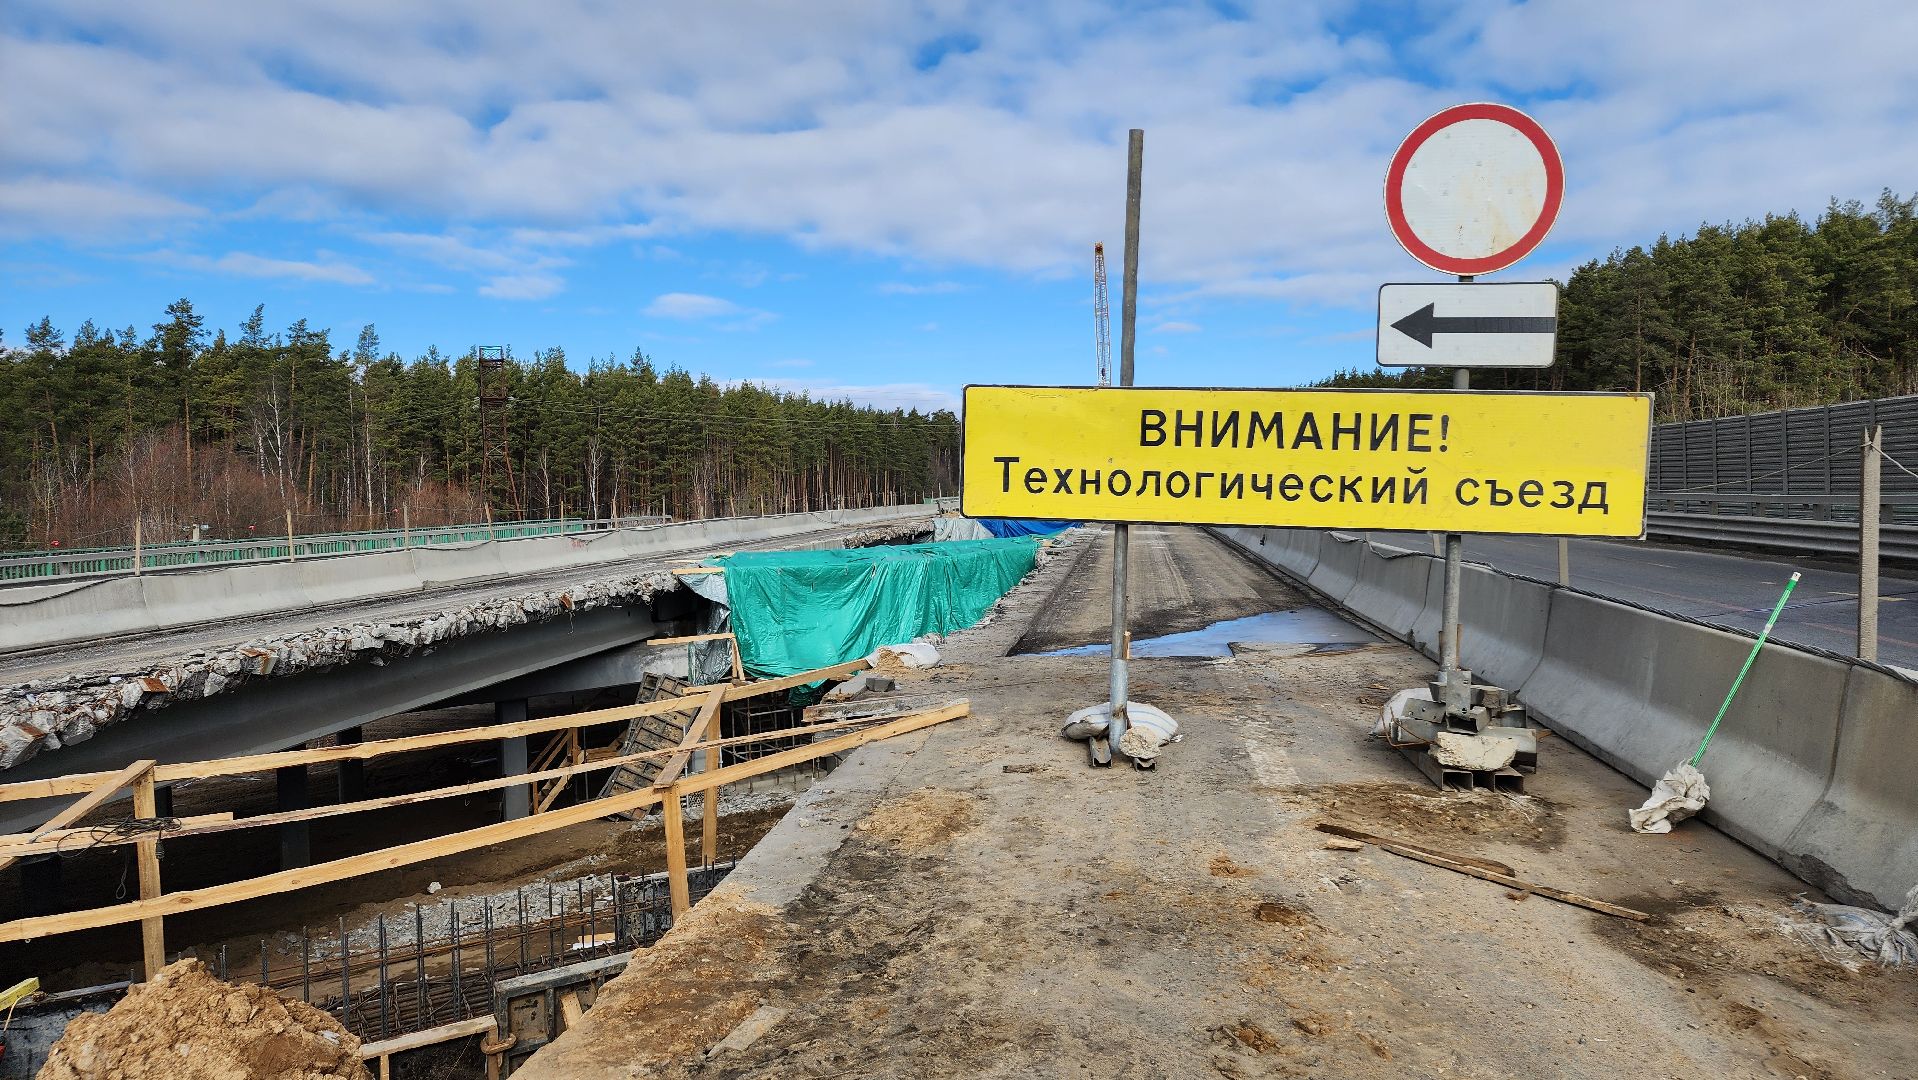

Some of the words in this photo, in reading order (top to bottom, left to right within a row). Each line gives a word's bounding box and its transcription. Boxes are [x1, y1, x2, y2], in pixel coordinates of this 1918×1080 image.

[1140, 409, 1450, 453] ВНИМАНИЕ!
[993, 456, 1428, 505] Технологический
[1455, 477, 1609, 515] съезд
